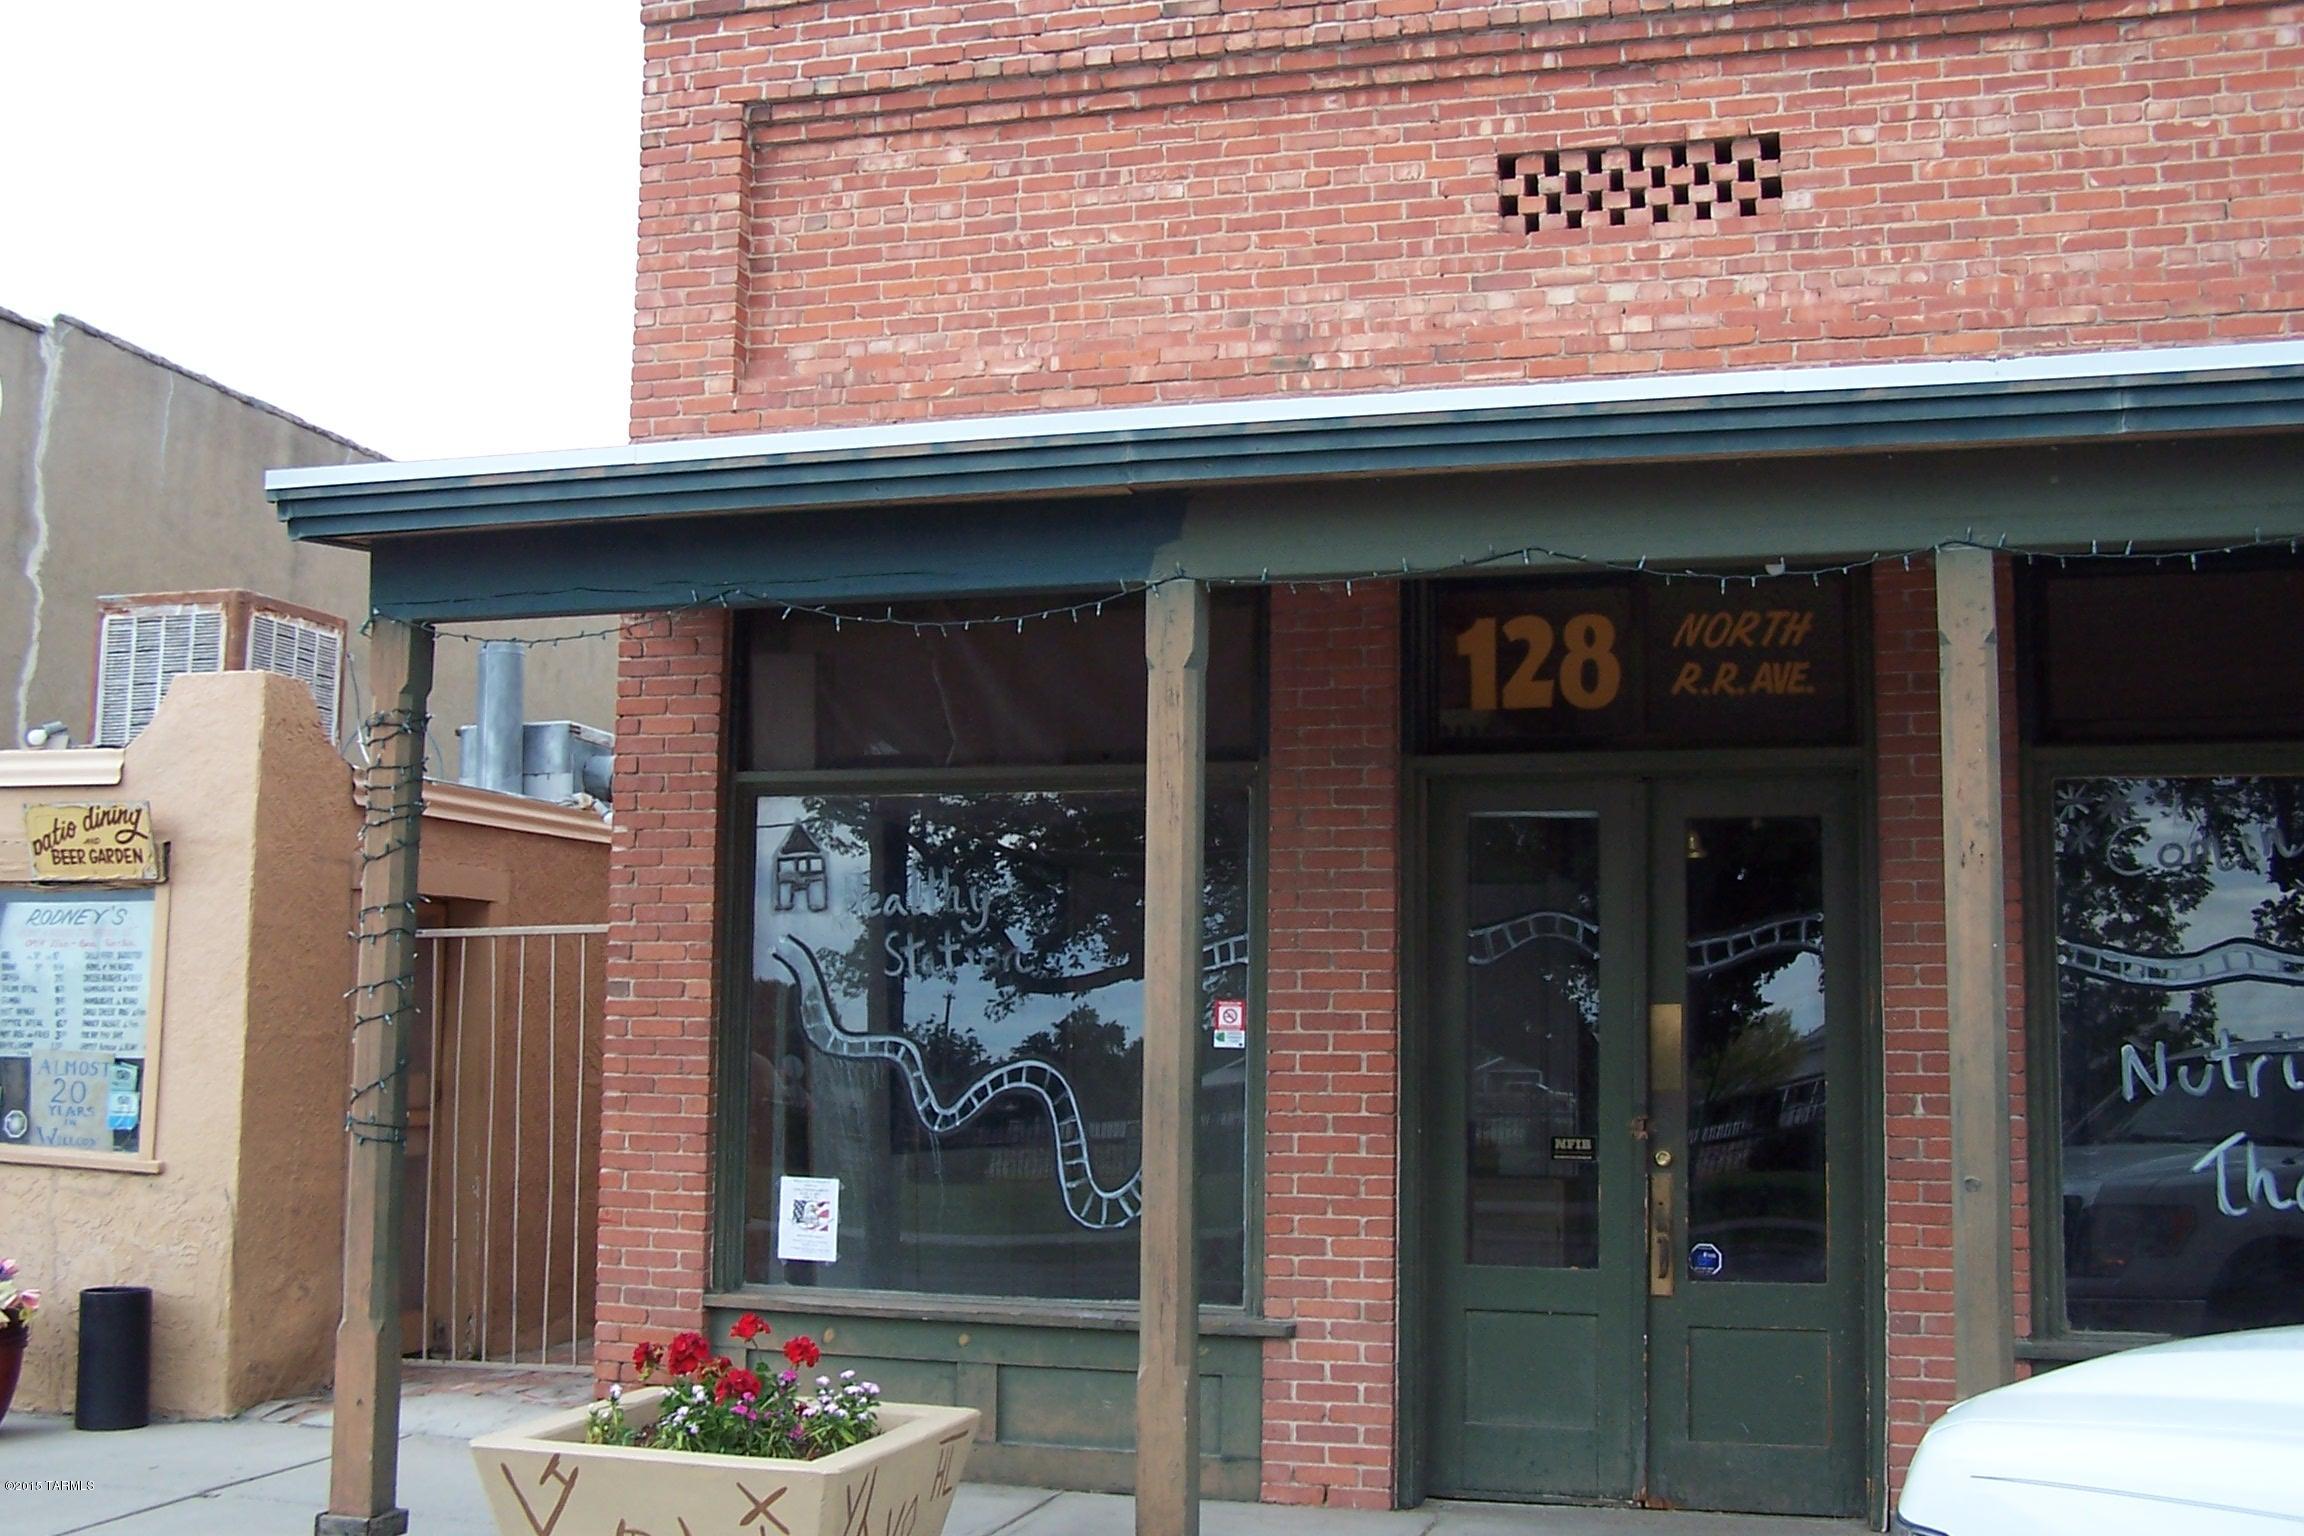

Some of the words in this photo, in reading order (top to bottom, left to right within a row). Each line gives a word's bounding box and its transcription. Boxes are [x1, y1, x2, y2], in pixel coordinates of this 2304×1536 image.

[1672, 609, 1813, 648] NORTH
[1457, 613, 1622, 711] 128
[33, 818, 77, 856] patio
[83, 805, 148, 845] dining
[52, 849, 86, 865] BEER
[89, 848, 143, 864] GARDEN
[26, 905, 129, 926] RODNEY'S
[37, 1059, 110, 1077] ALMOST
[50, 1077, 87, 1104] 20
